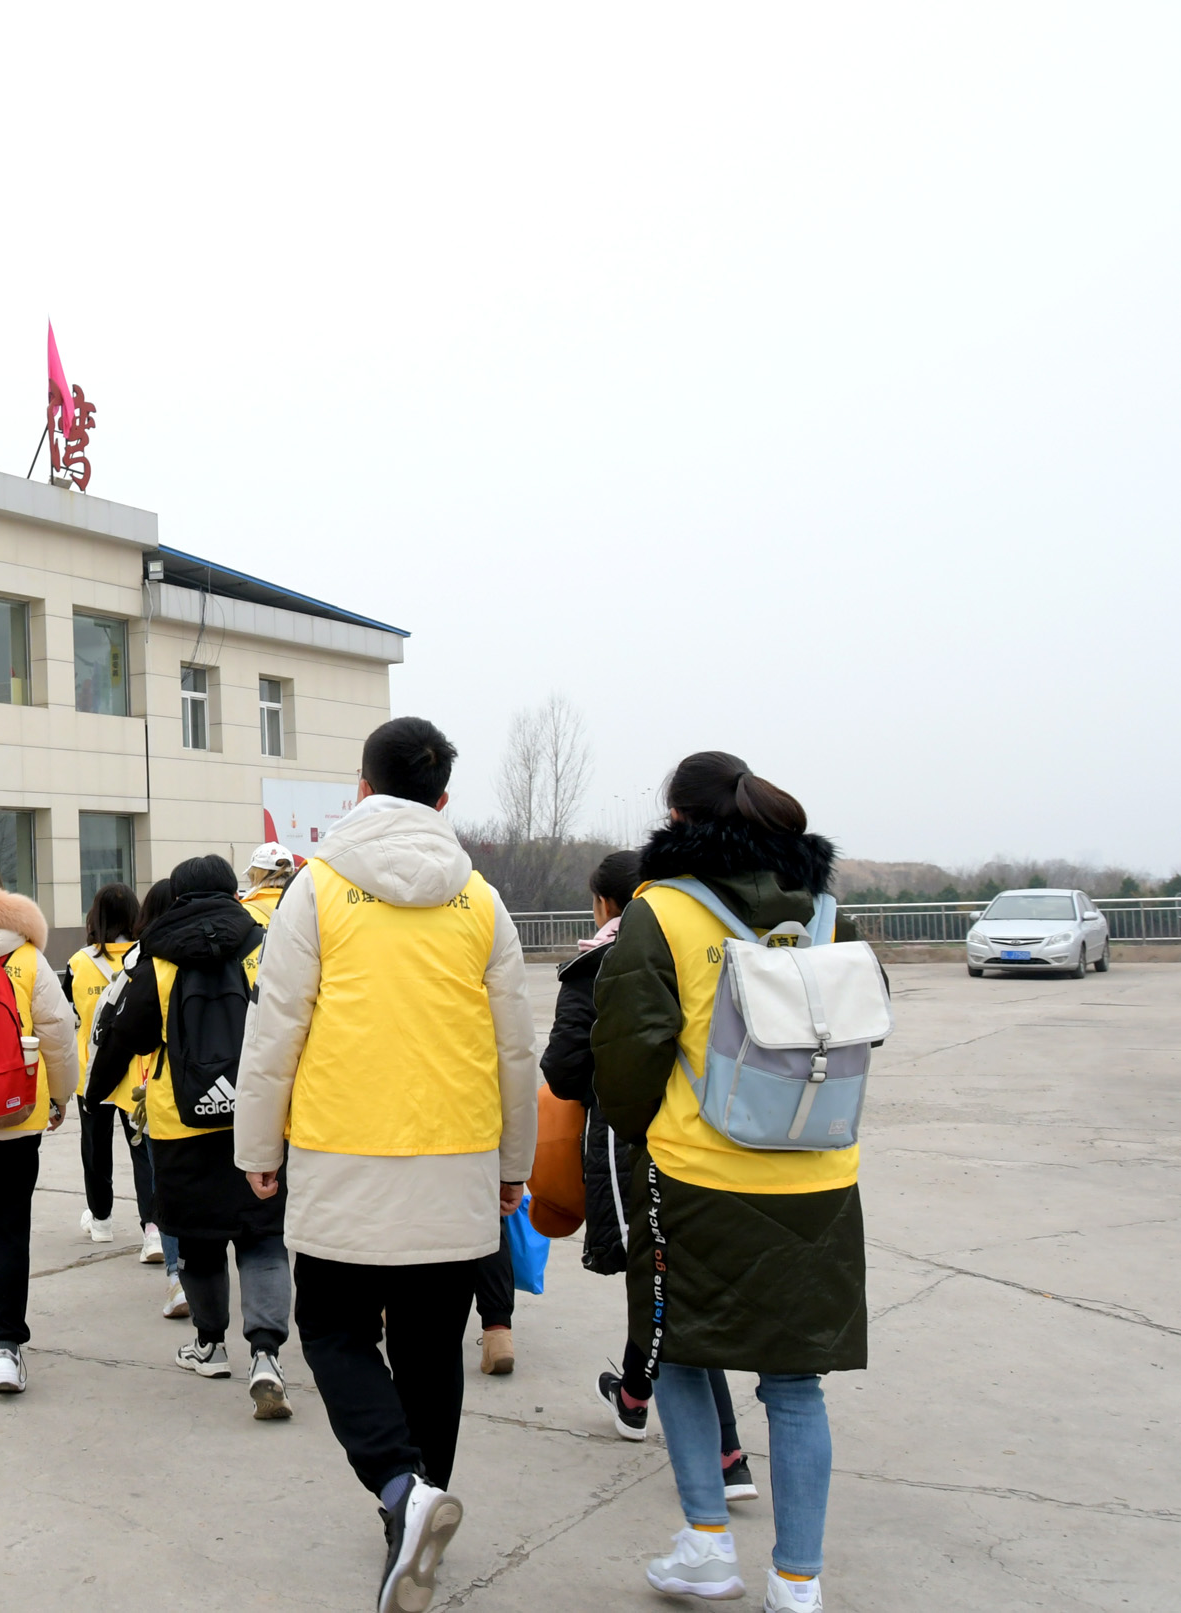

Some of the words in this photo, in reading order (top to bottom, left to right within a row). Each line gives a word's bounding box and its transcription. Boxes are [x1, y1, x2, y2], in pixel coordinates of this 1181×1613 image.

[707, 944, 724, 964] 心
[194, 1100, 235, 1115] adid
[650, 1187, 661, 1204] to
[654, 1249, 666, 1271] go
